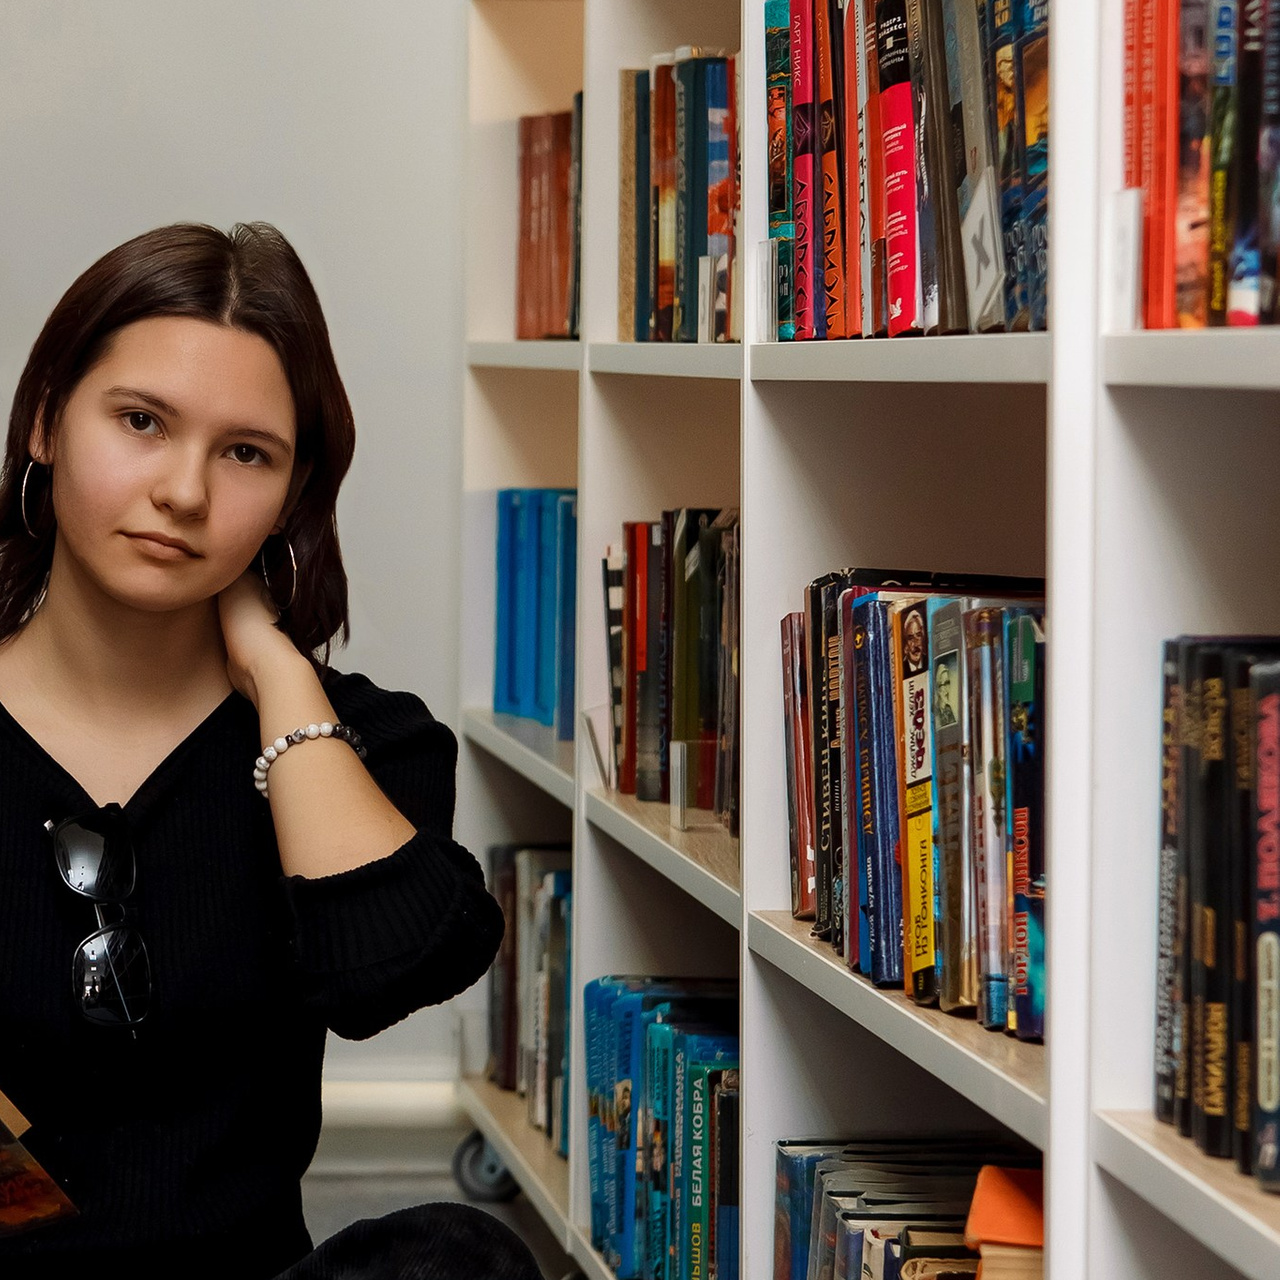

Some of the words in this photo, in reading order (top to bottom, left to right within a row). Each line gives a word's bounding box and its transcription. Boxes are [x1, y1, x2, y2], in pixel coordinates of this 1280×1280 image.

[793, 14, 802, 44] ГАРТ
[793, 49, 803, 88] НИКС
[857, 107, 867, 253] ШЁПОТ
[823, 173, 841, 332] САБРИЭЛЬ
[909, 729, 917, 780] ДЖЕЙМС
[820, 749, 830, 852] СТИВЕН
[866, 855, 875, 909] мужчина
[1013, 806, 1031, 898] ДИКСОН
[919, 839, 928, 931] ГОНКОНГА
[921, 935, 928, 956] ИЗ
[1014, 911, 1029, 996] ГОРДОН
[691, 1078, 703, 1141] КОБРА
[691, 1145, 703, 1208] БЕЛАЯ
